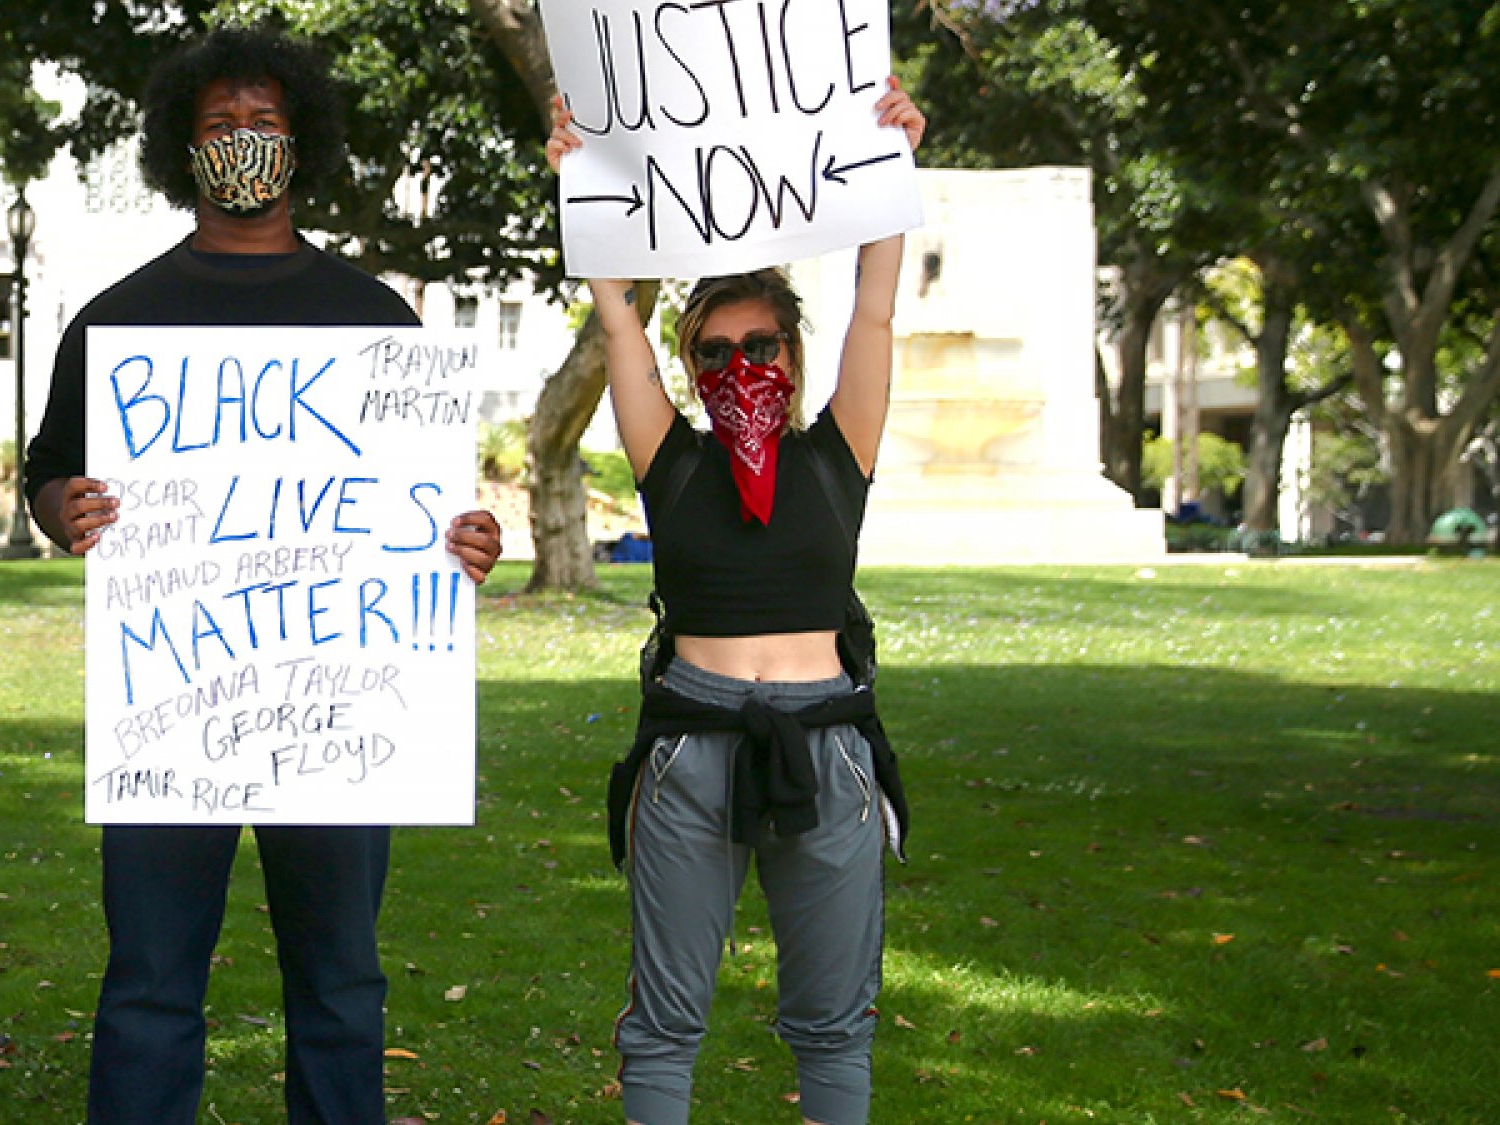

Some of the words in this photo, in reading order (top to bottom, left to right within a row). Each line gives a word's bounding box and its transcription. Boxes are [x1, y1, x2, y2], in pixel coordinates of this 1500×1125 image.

[563, 0, 875, 135] JUSTICE
[646, 130, 823, 251] NOW
[358, 335, 477, 385] TRAYVON
[110, 354, 362, 460] BLACK
[359, 390, 472, 426] MARTIN
[98, 514, 203, 560] GRANT
[208, 475, 443, 553] LIVES
[107, 560, 221, 611] AHMAUD
[235, 541, 352, 584] ARBERY
[120, 570, 461, 705] MATTER!!!
[114, 664, 259, 760] BREONNA
[275, 656, 407, 709] TAYLOR
[202, 702, 355, 762] GEORGE
[92, 764, 183, 803] TAMIR
[193, 778, 275, 815] RICE
[271, 732, 396, 786] FLOYD
